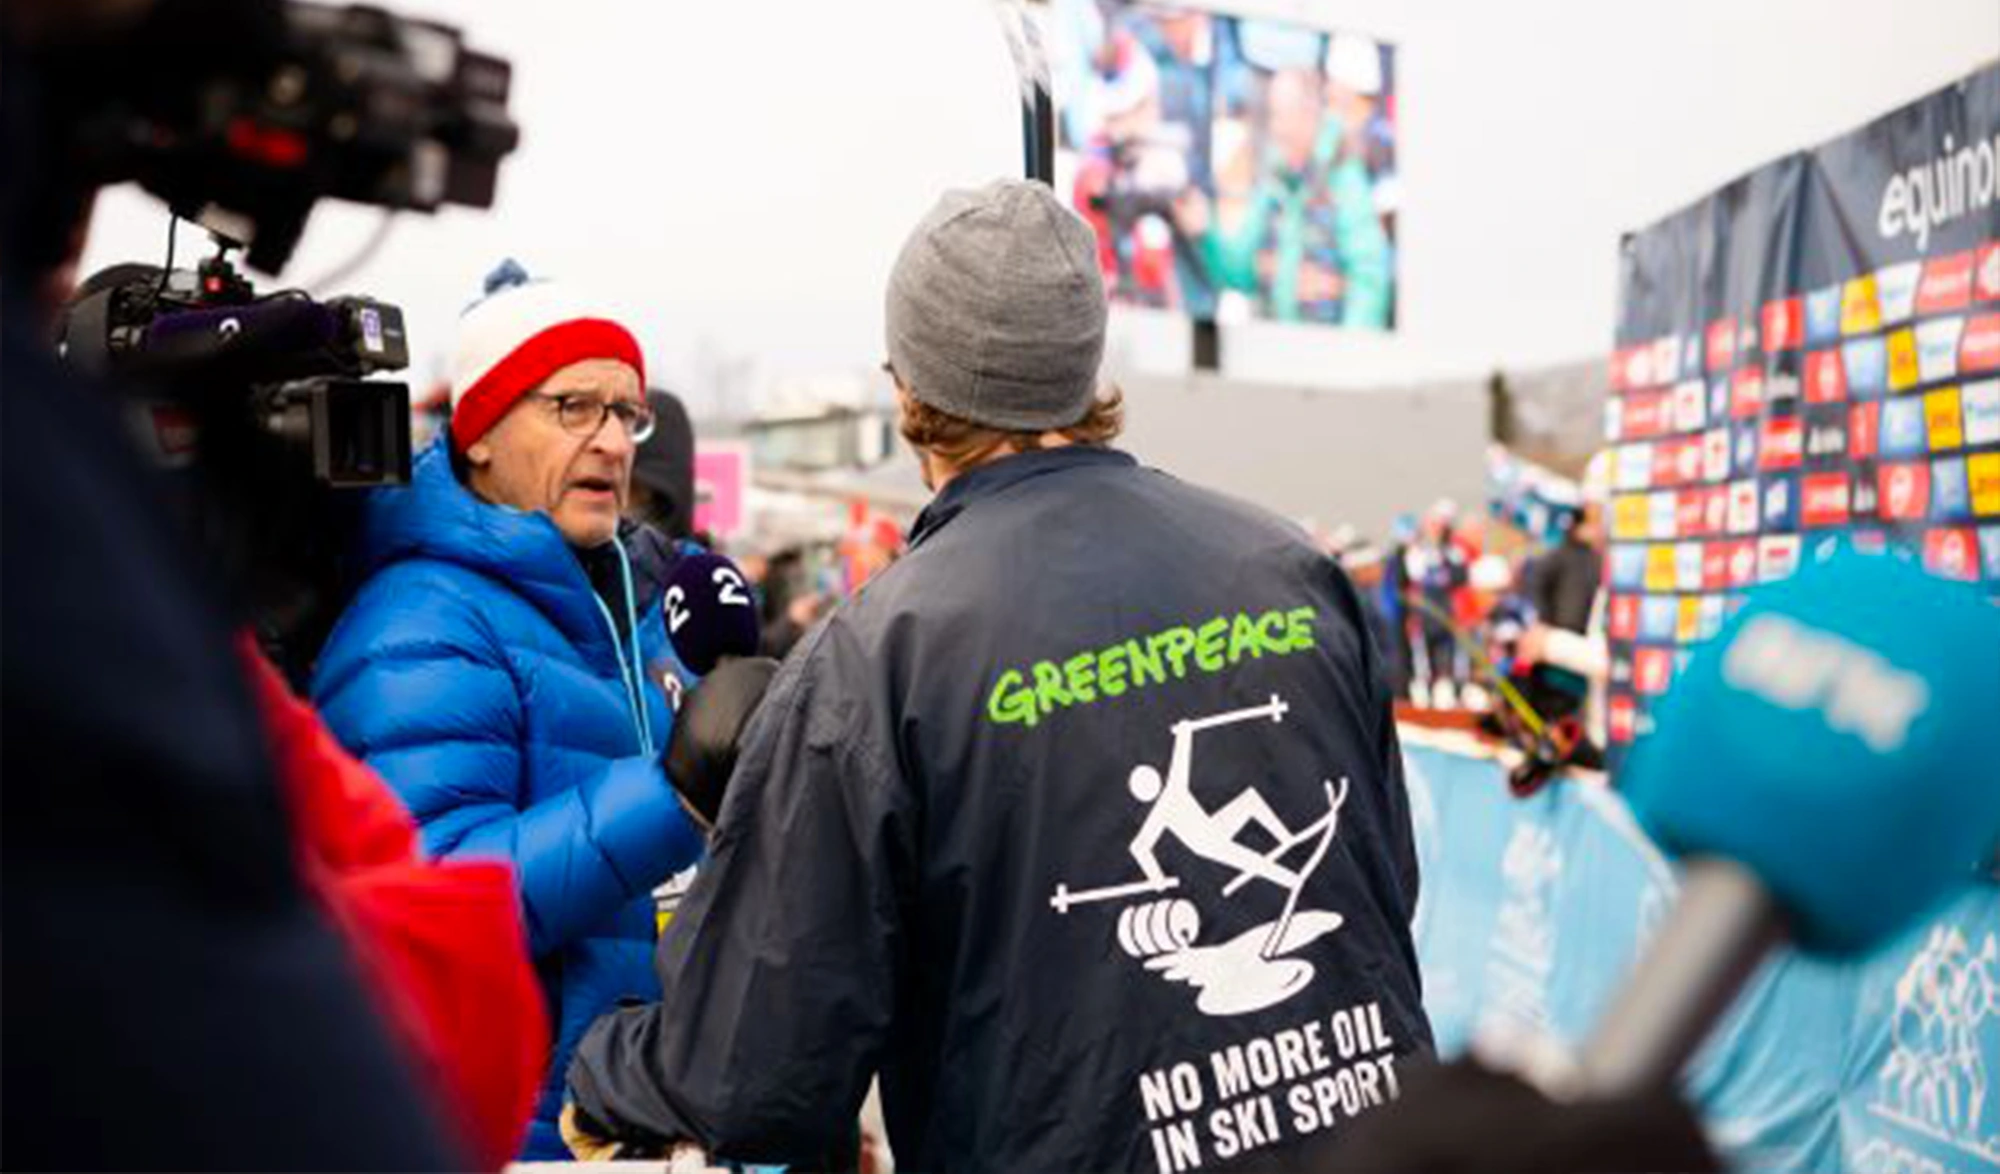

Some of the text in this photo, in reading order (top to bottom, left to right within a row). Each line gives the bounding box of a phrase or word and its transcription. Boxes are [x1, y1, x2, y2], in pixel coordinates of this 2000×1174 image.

[664, 585, 690, 633] 2
[711, 567, 749, 605] 2
[987, 606, 1315, 726] GREENPEACE
[1139, 1002, 1393, 1122] NO MORE OIL
[1151, 1053, 1400, 1174] IN SKI SPORT
